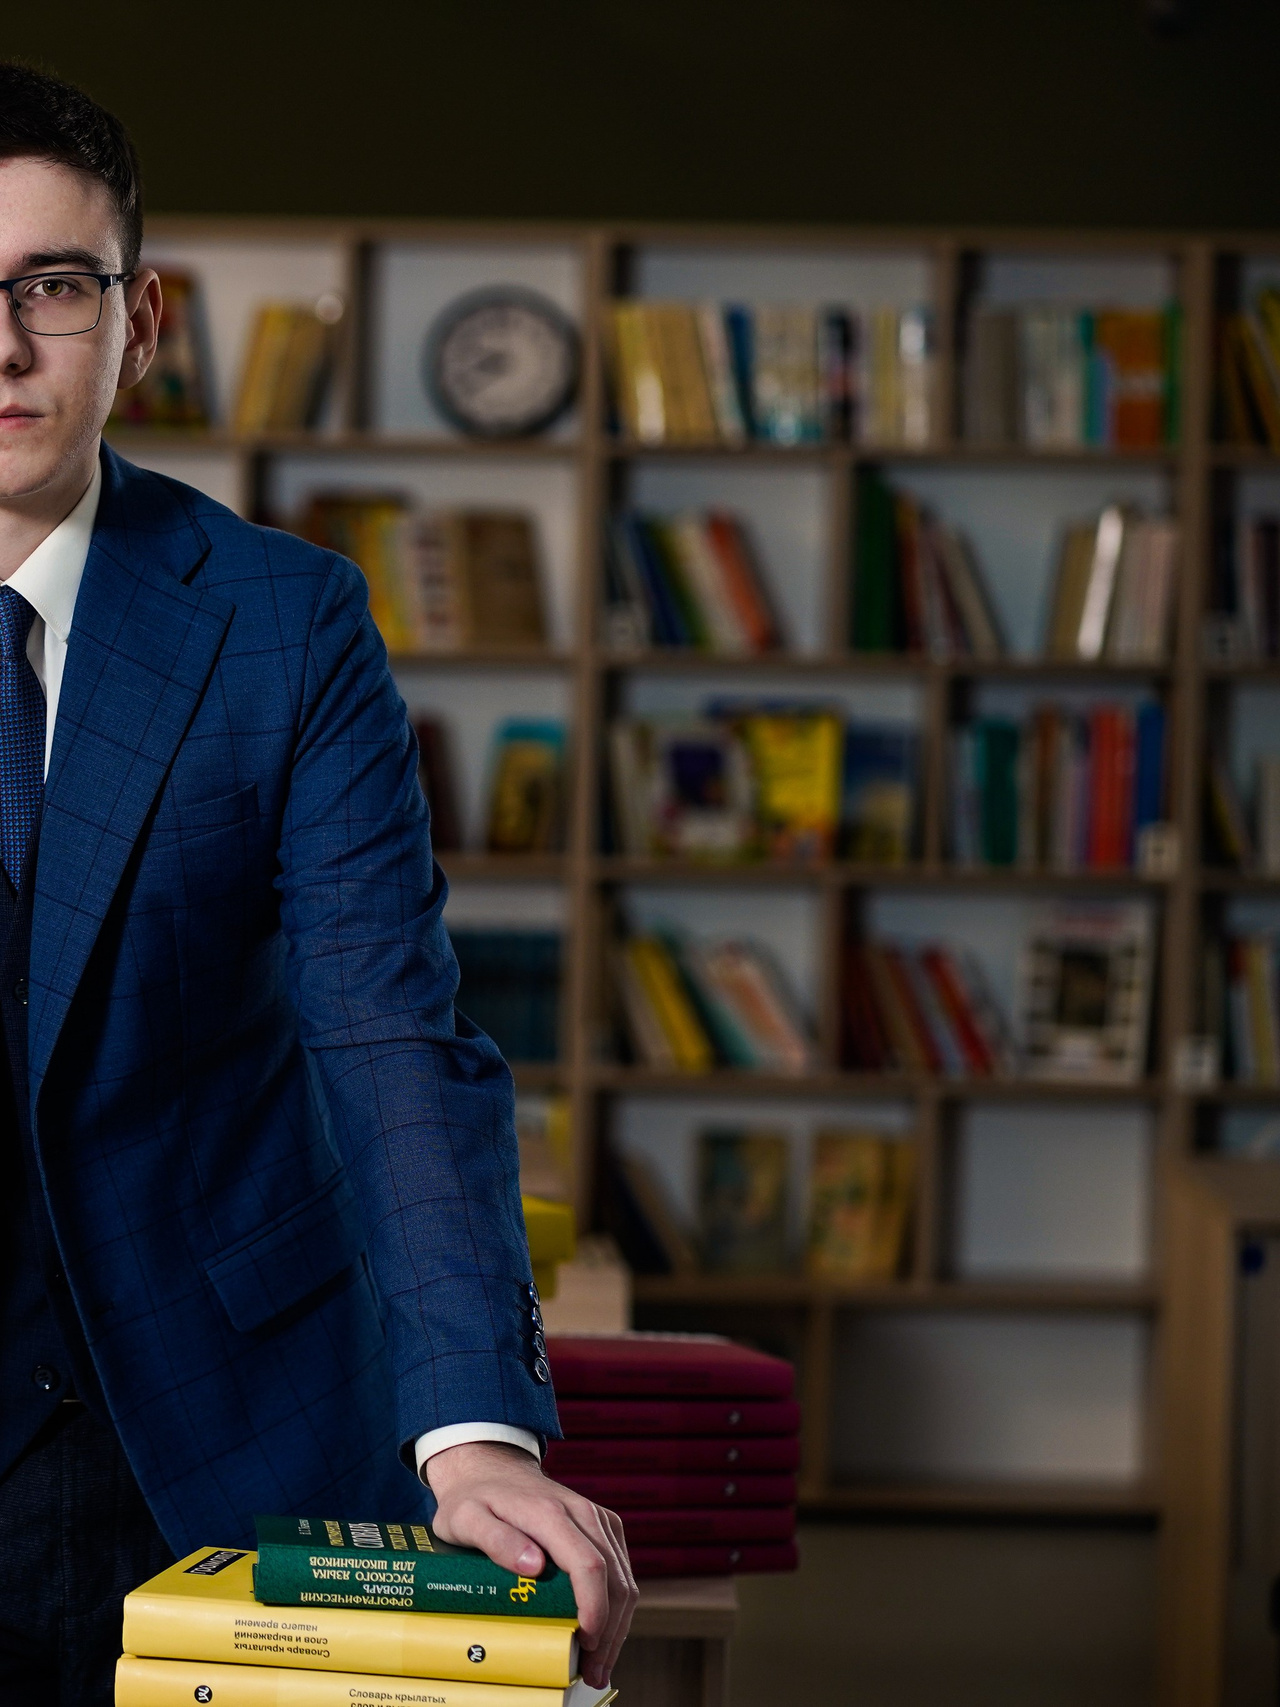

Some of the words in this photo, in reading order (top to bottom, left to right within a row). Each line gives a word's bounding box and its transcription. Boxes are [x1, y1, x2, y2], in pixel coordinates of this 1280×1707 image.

[309, 1556, 387, 1570] ШКОЛЬНИКОВ
[392, 1560, 416, 1572] ДЛЯ
[312, 1569, 350, 1580] ЯЗЫКА
[355, 1572, 414, 1584] РУССКОГО
[363, 1584, 414, 1596] СЛОВАРЬ
[427, 1582, 474, 1594] Ткаченко
[487, 1585, 497, 1595] Н.
[300, 1592, 413, 1607] ОРФОГРАФИЧЕСКИЙ
[235, 1619, 279, 1629] времени
[281, 1623, 318, 1632] нашего
[234, 1631, 293, 1641] выражений
[304, 1636, 328, 1645] слов
[234, 1642, 284, 1653] крылатых
[287, 1645, 330, 1658] Словарь
[349, 1688, 393, 1701] Словарь
[395, 1694, 446, 1704] крылатых
